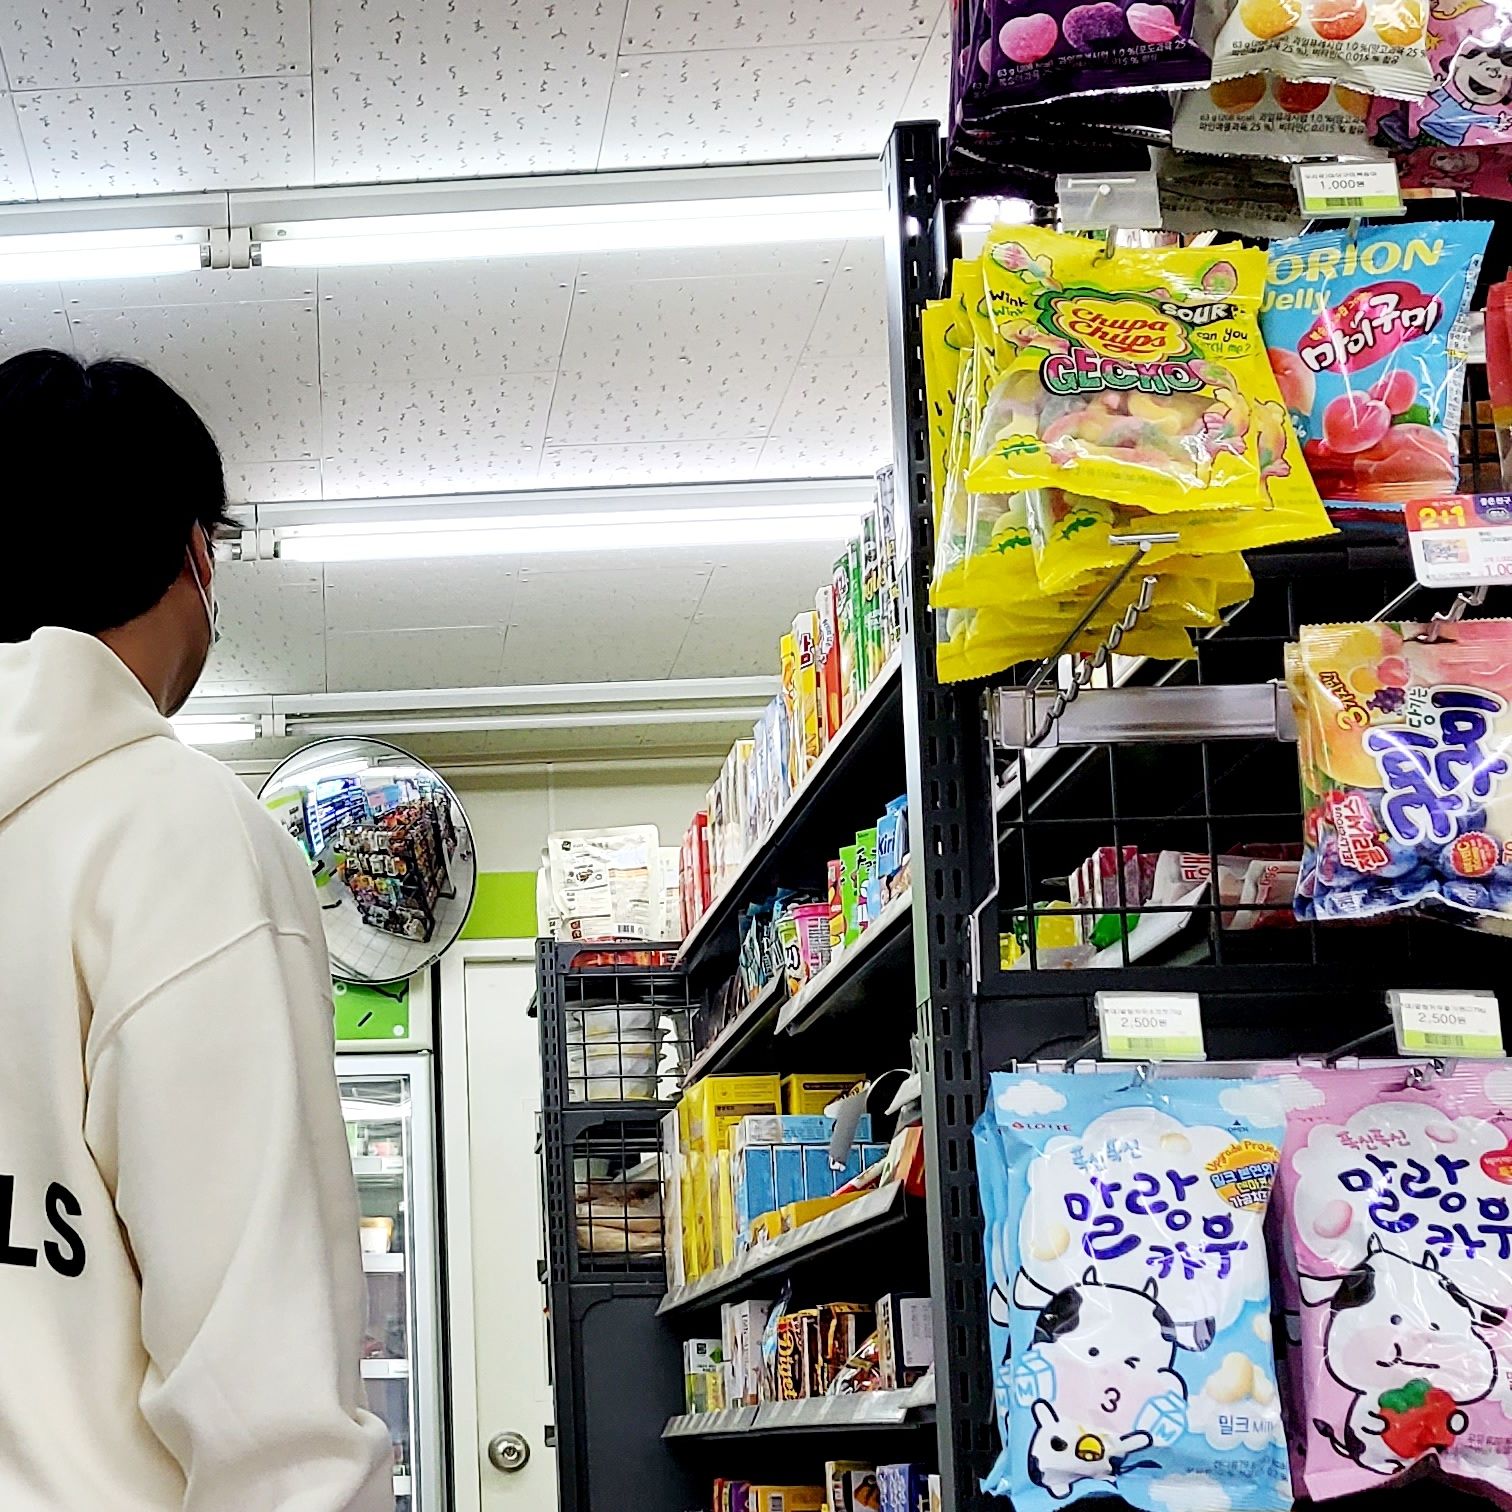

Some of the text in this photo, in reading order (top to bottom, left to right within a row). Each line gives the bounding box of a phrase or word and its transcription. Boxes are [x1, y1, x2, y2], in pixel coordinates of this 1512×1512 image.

[1320, 180, 1365, 190] 1,000원
[1268, 240, 1444, 285] ORION
[990, 290, 1028, 307] Wink
[1072, 307, 1168, 332] Chupa
[1163, 304, 1230, 323] SOUR
[1070, 321, 1166, 352] Chups
[1225, 327, 1248, 341] you
[1301, 292, 1442, 372] 마이구미
[1046, 349, 1200, 391] GECKO
[1420, 507, 1465, 529] 2+1
[1122, 1018, 1166, 1028] 2,500원
[1419, 1013, 1465, 1025] 2,500원
[1024, 1124, 1071, 1132] LOTTE
[1338, 1155, 1469, 1233] 말랑
[1066, 1170, 1198, 1260] 말랑
[1146, 1214, 1247, 1279] 카우
[1220, 1415, 1249, 1435] 밀크
